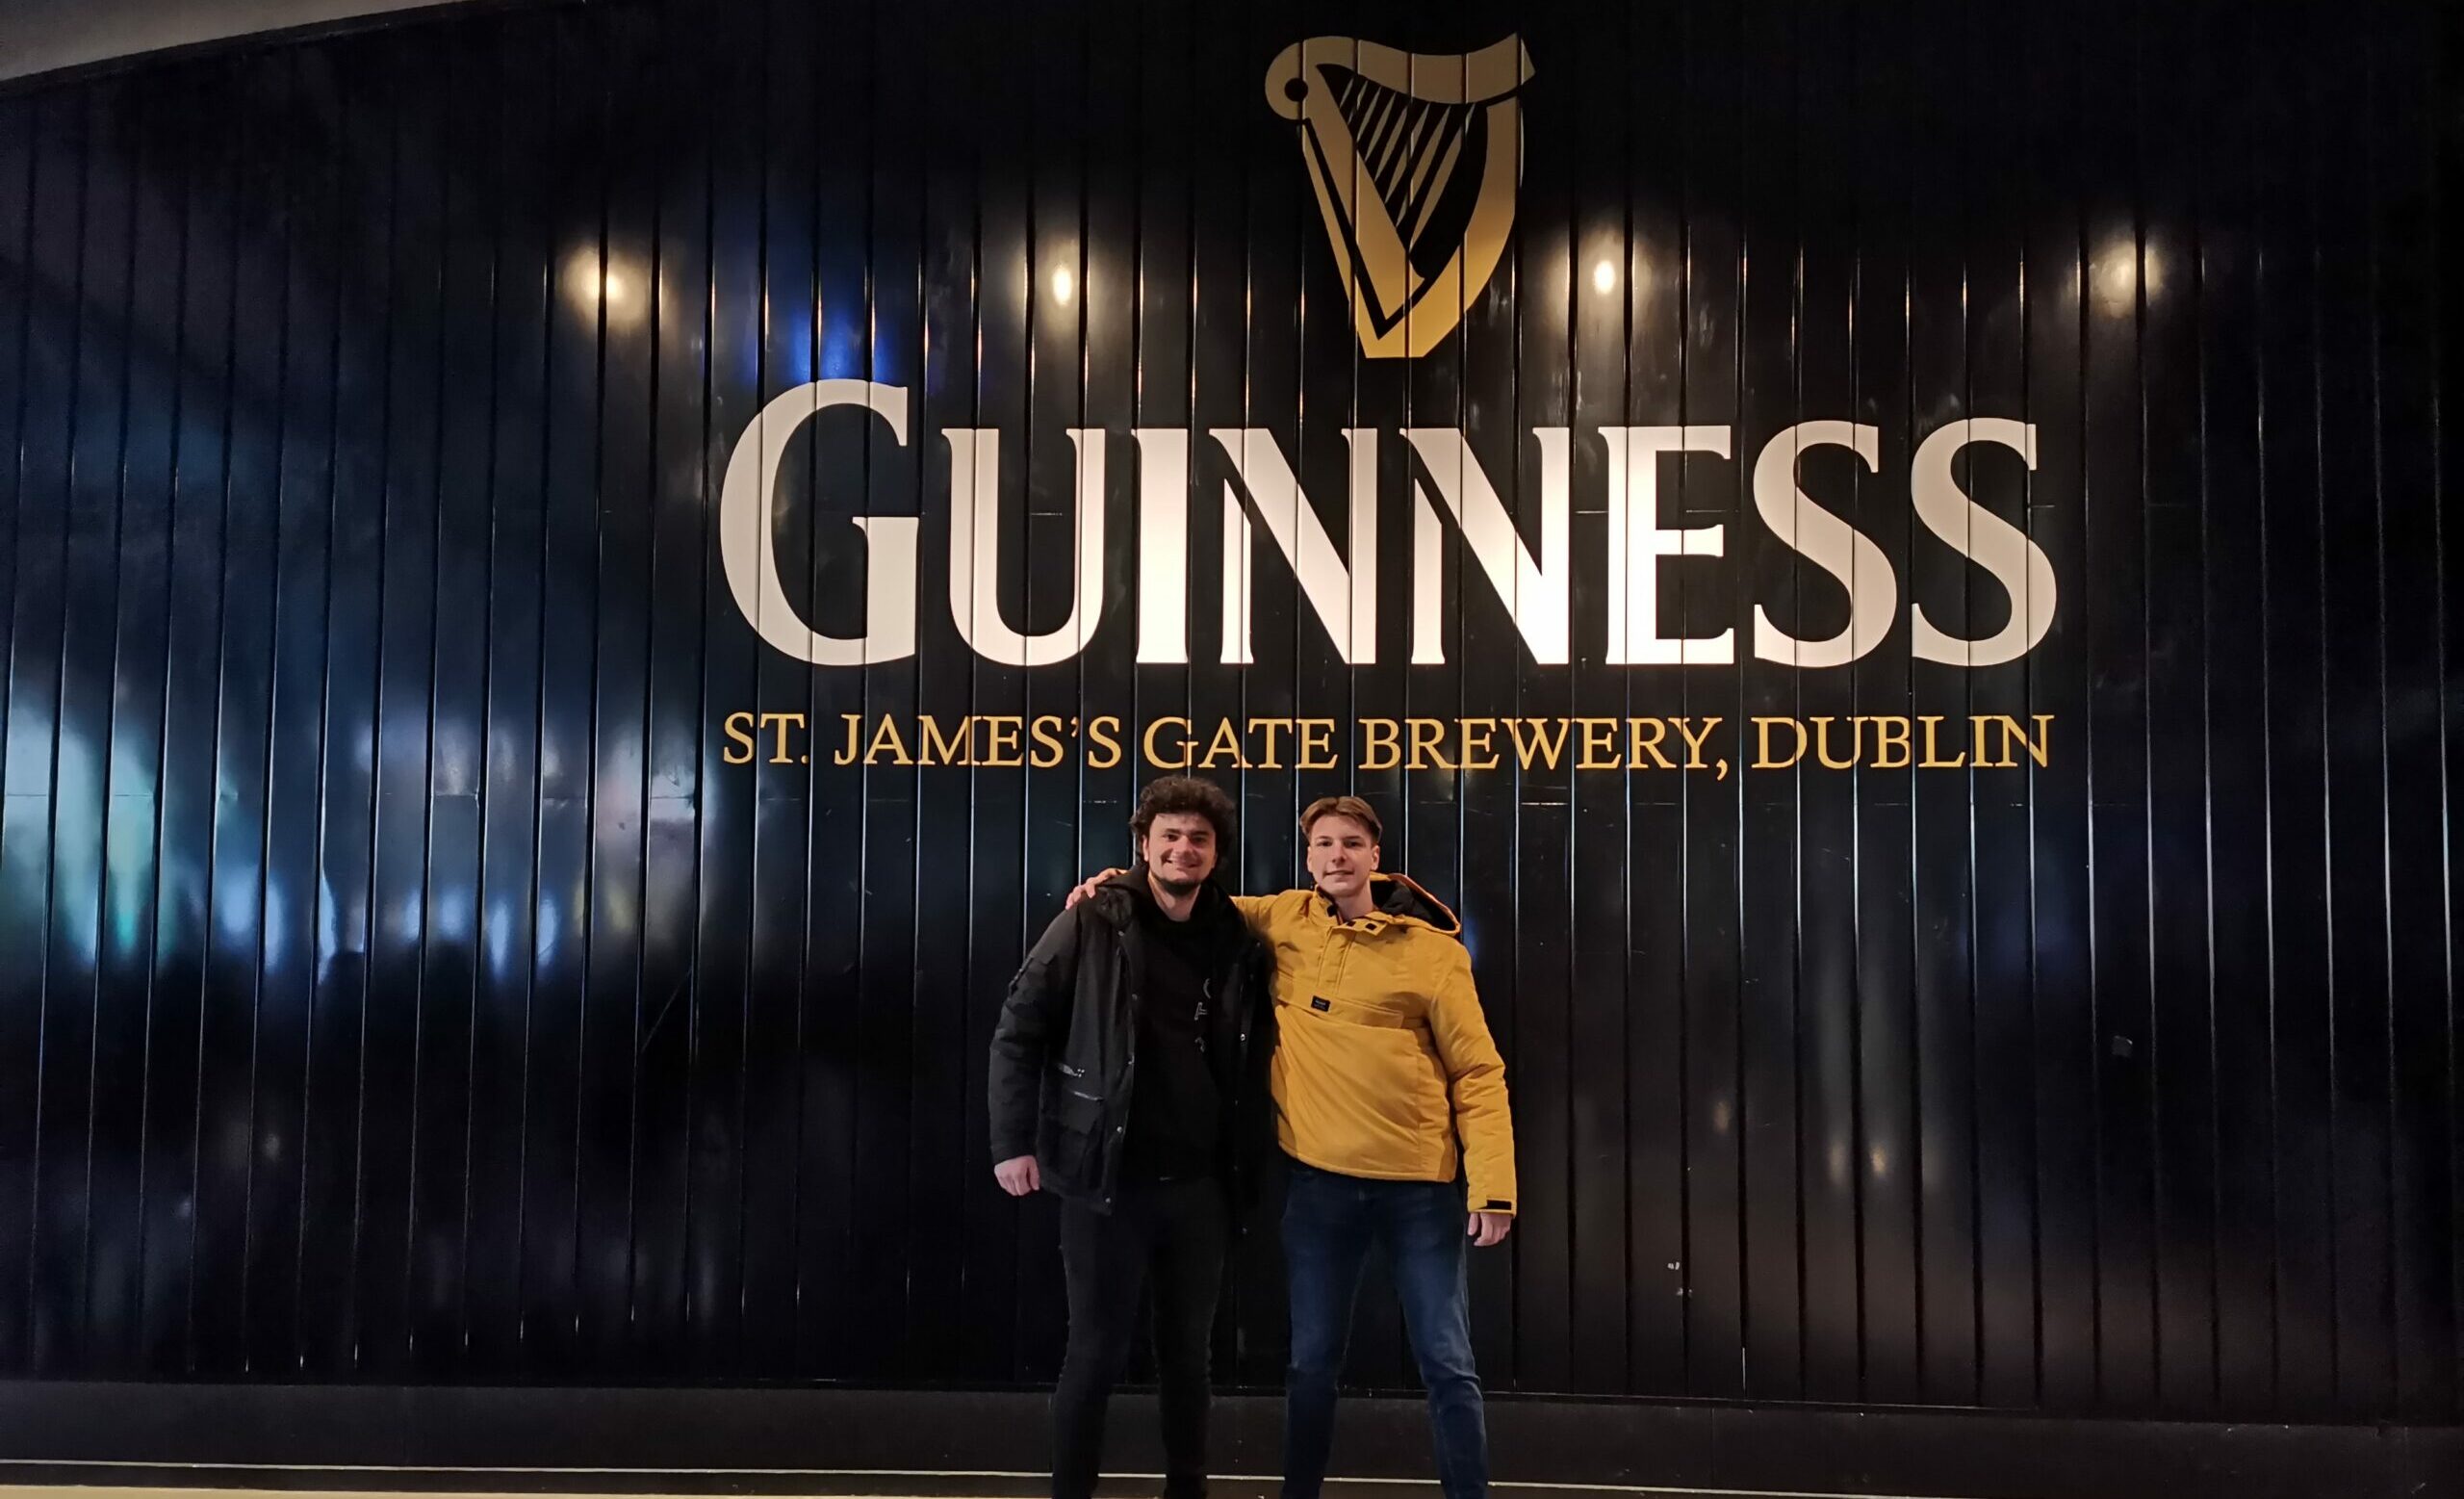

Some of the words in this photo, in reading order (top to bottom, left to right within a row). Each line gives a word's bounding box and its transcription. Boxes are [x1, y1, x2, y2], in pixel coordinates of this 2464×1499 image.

[720, 378, 2057, 667] GUINNESS
[723, 712, 808, 764] ST.
[1142, 716, 1337, 769] GATE
[1358, 716, 1729, 781] BREWERY,
[1751, 715, 2055, 769] DUBLIN
